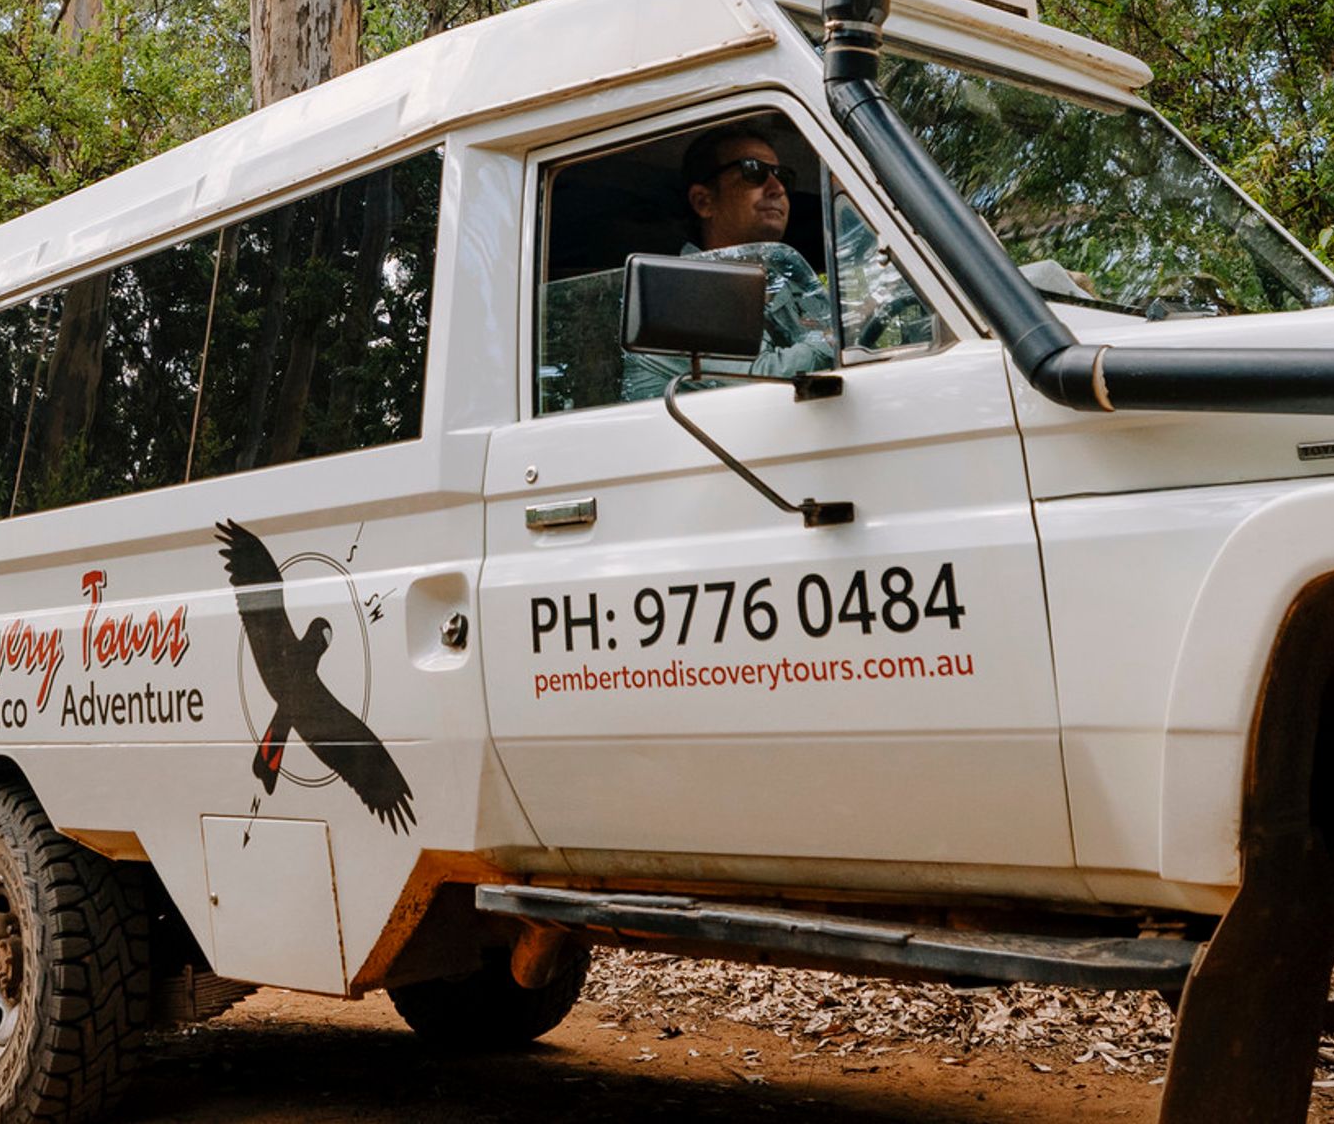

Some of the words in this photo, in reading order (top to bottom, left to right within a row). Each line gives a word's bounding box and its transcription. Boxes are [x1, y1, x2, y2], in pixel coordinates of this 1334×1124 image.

[82, 570, 190, 670] Tours
[530, 592, 618, 654] PH:
[633, 577, 779, 648] 9776
[797, 561, 966, 639] 0484
[61, 680, 205, 728] Adventure
[534, 651, 975, 700] pembertondiscoverytours.com.au
